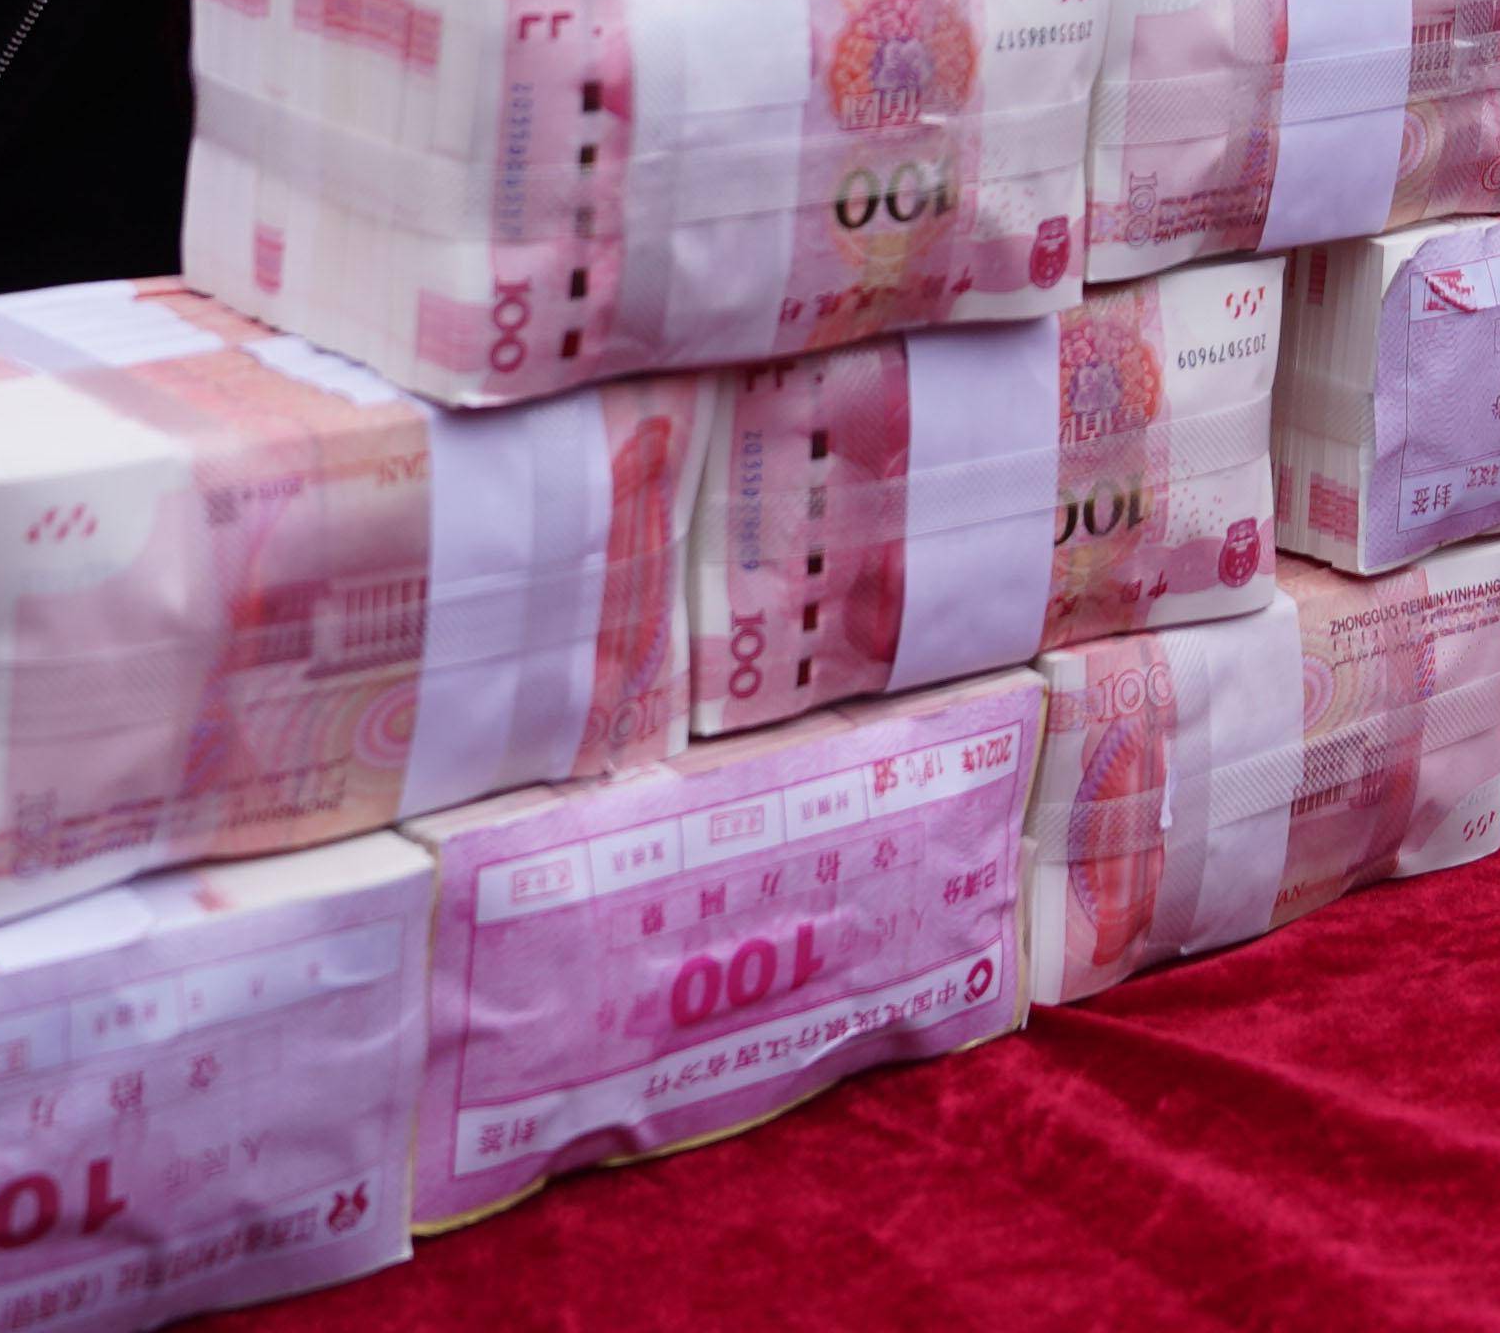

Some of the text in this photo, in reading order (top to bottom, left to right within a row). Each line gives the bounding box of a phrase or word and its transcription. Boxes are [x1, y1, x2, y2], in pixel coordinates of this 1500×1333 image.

[491, 277, 532, 373] 100
[1411, 484, 1451, 514] 封签
[1330, 606, 1399, 635] ZHONGGUO
[1446, 579, 1500, 606] YINHANG
[728, 608, 766, 699] 100
[670, 922, 825, 1029] 100
